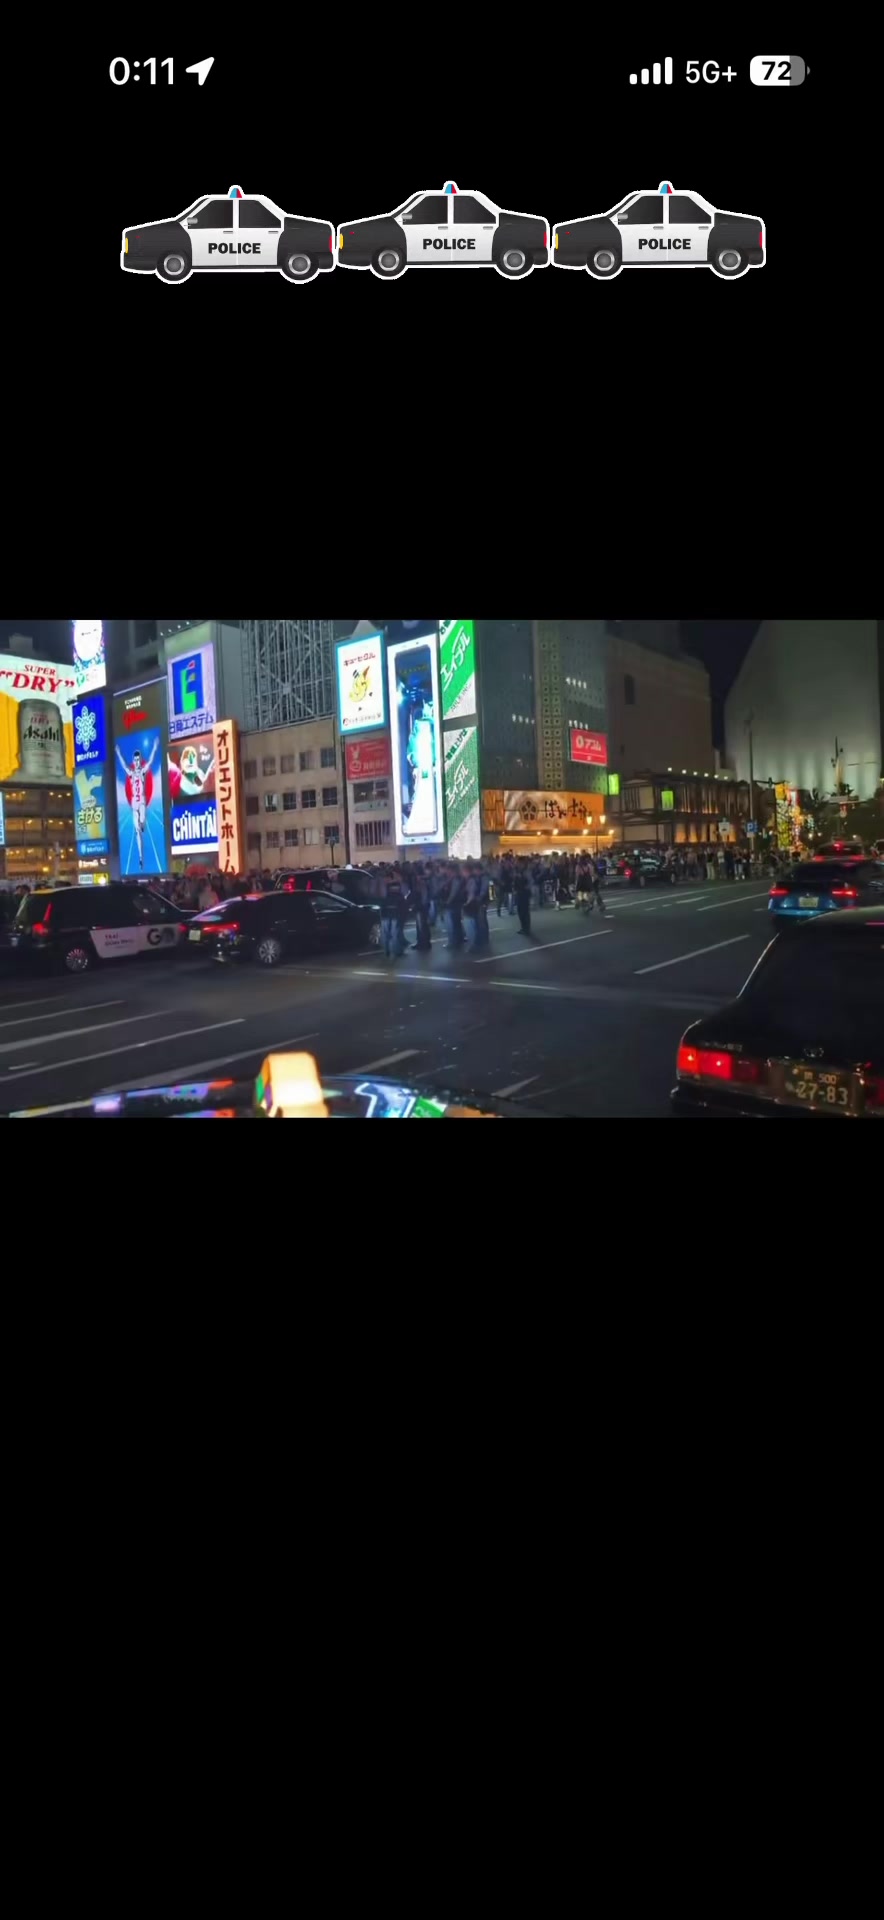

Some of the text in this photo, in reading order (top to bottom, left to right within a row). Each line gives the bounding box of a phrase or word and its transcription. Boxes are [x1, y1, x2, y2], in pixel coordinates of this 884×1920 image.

[441, 625, 471, 692] エイブル
[24, 664, 56, 676] SUPER
[23, 725, 59, 741] Asahi
[584, 738, 602, 752] アコム
[217, 729, 236, 874] オリエントホーム
[77, 807, 103, 826] さける
[818, 1073, 837, 1084] 500
[797, 1081, 848, 1105] 27-83
